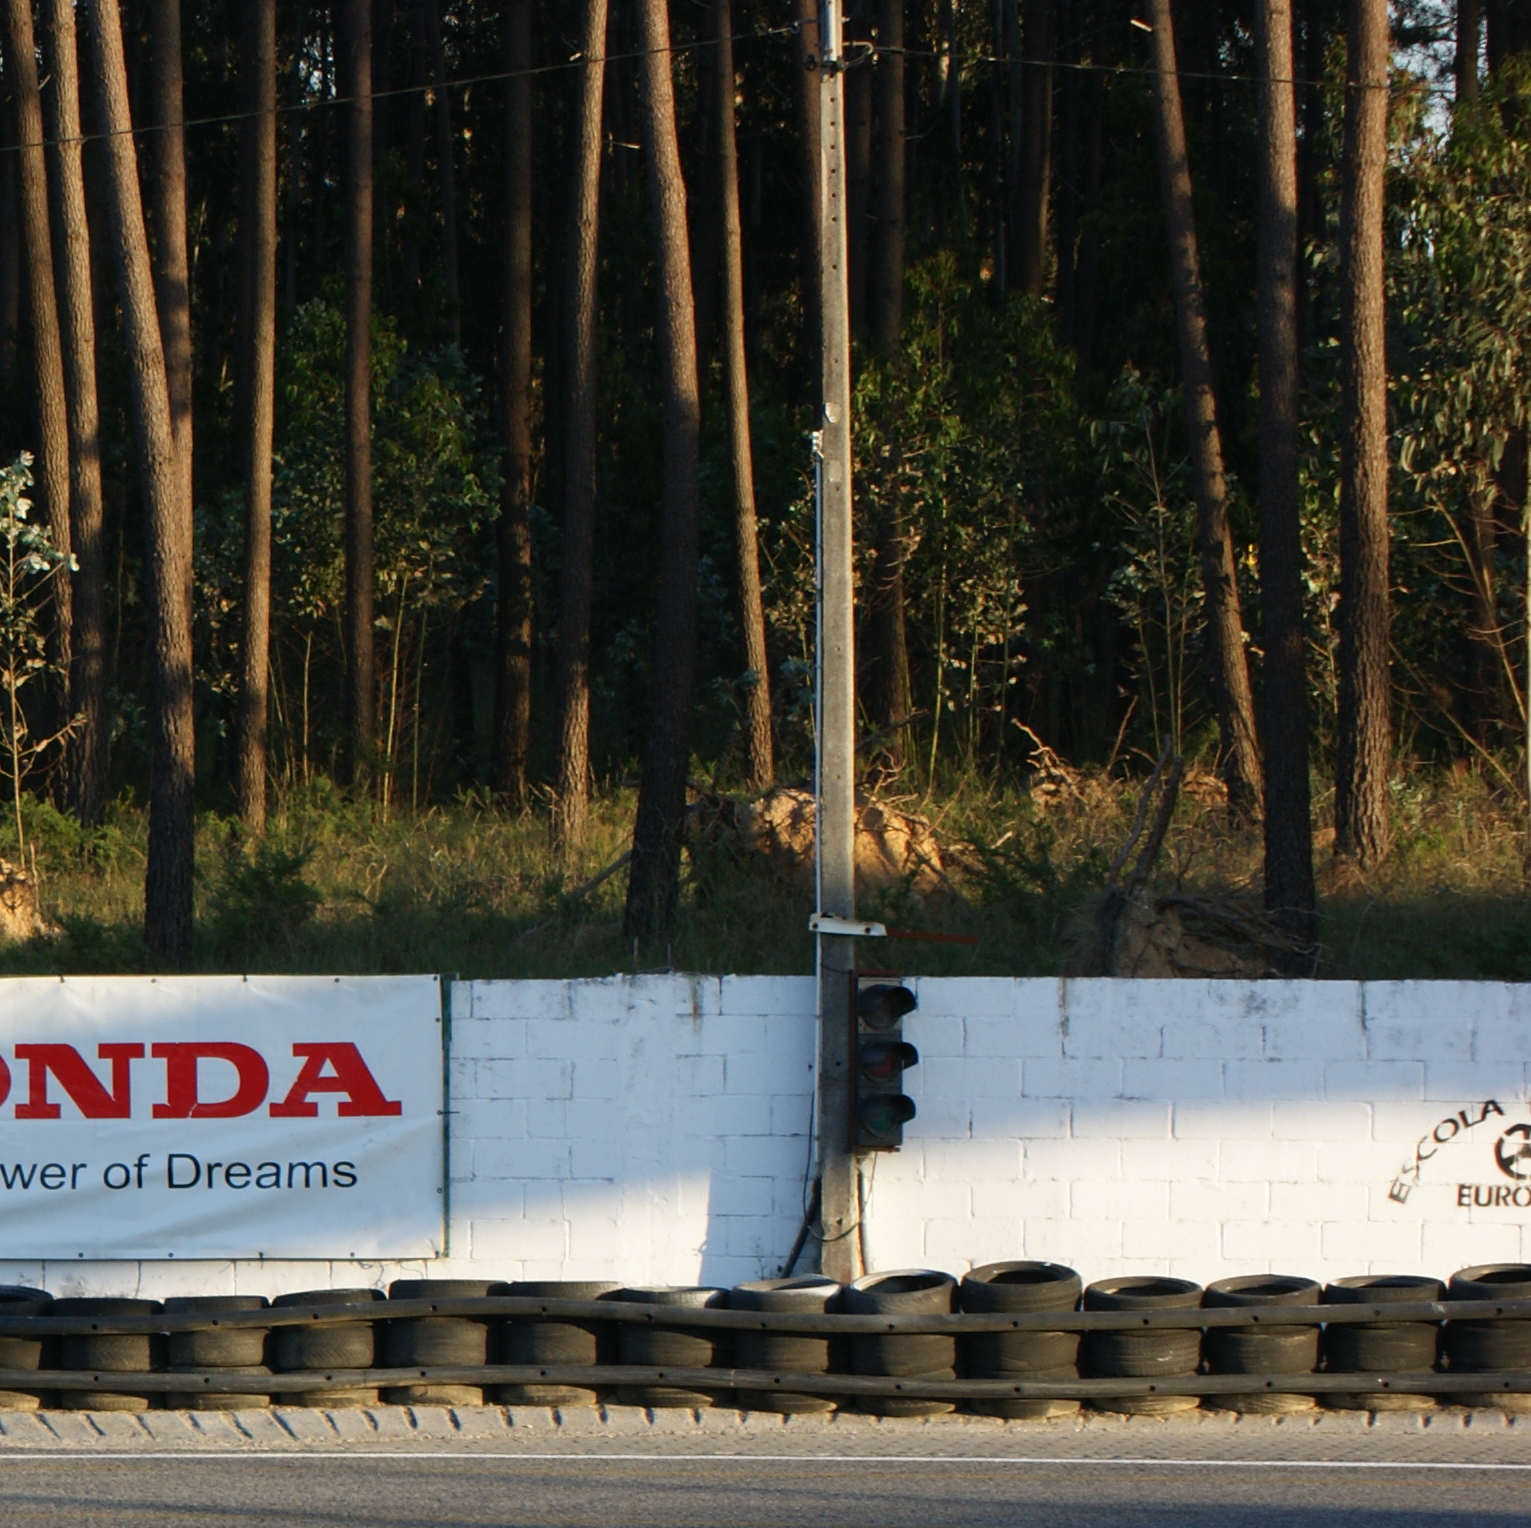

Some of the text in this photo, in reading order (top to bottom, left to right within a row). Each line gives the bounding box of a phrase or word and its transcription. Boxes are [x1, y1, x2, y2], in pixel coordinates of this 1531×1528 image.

[102, 1152, 151, 1190] of
[166, 1152, 359, 1190] Dreams
[1388, 1099, 1505, 1205] ESCOLA
